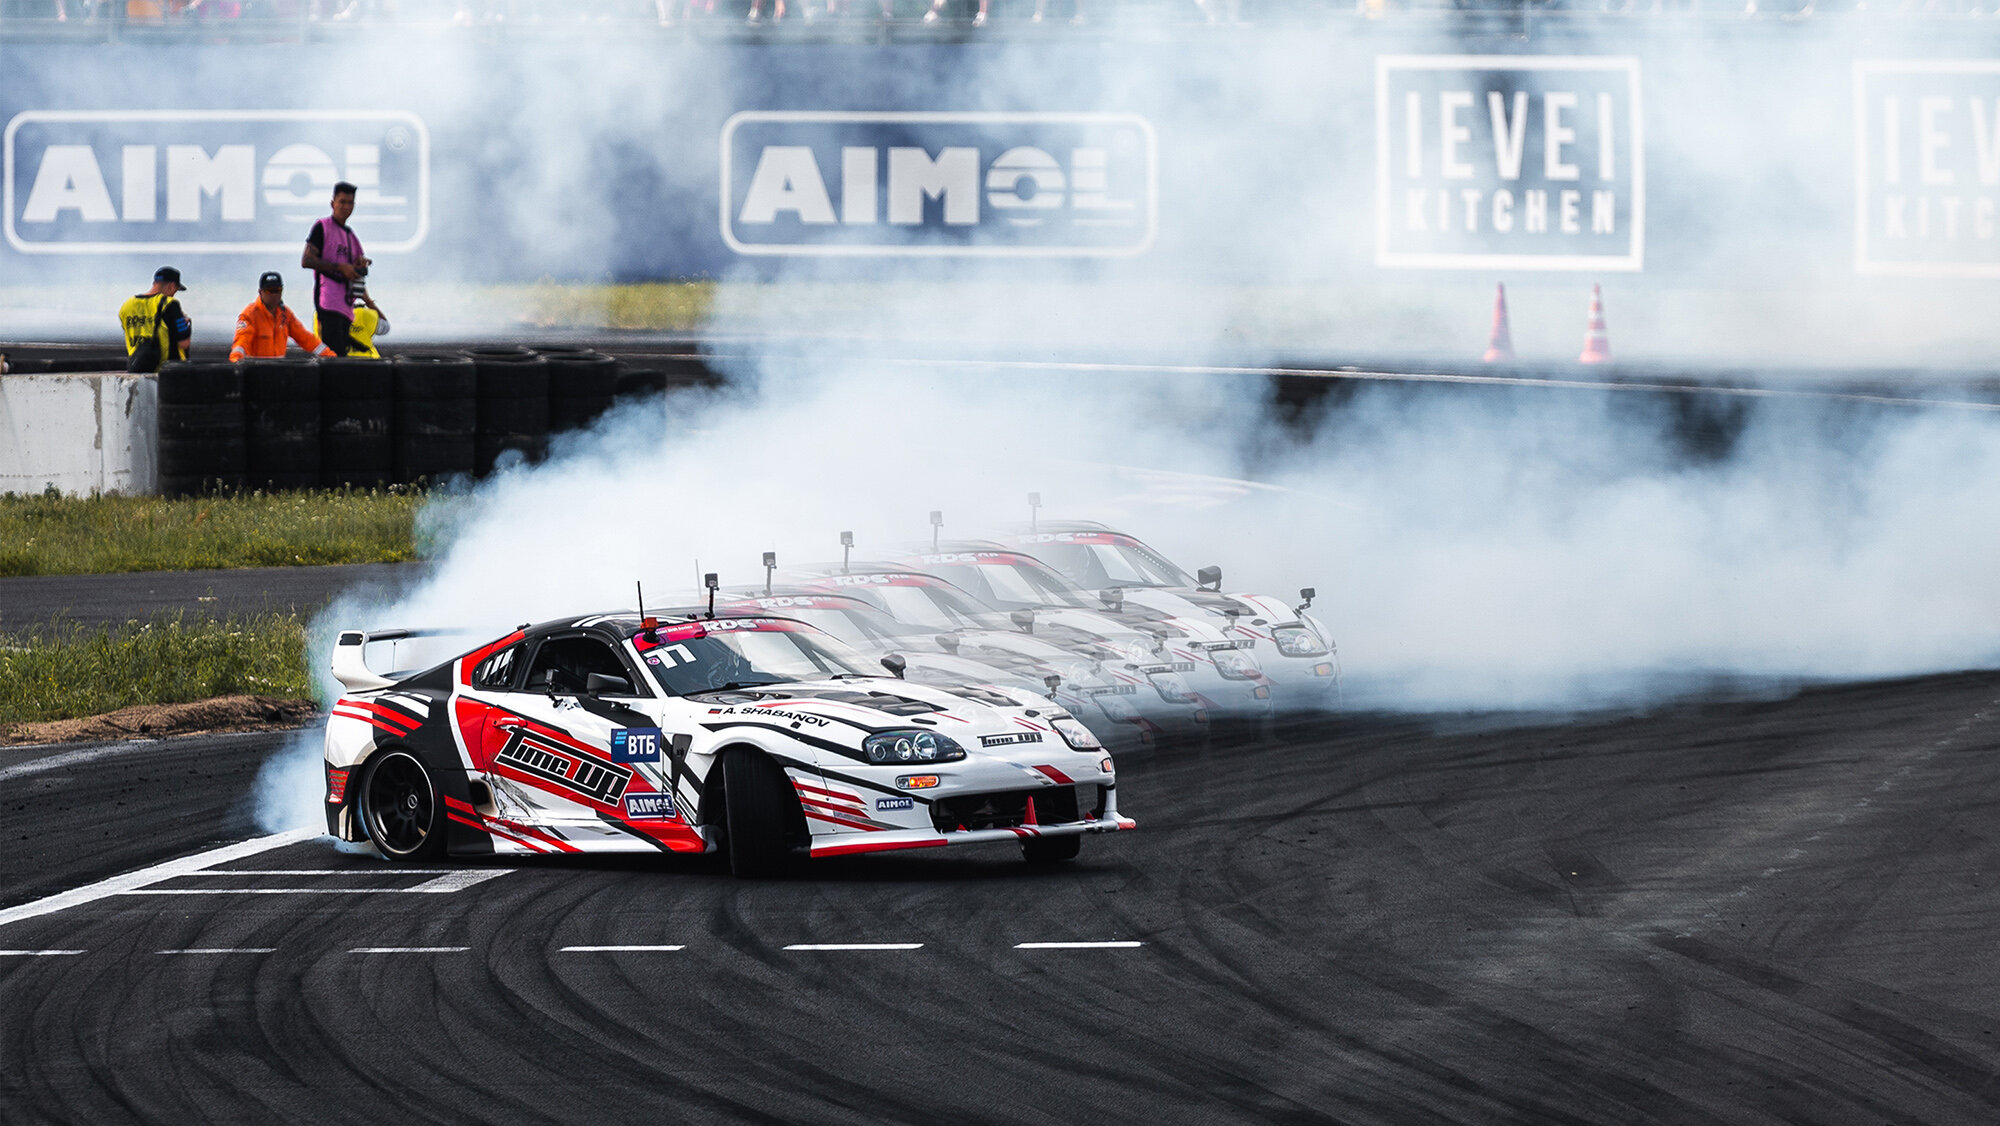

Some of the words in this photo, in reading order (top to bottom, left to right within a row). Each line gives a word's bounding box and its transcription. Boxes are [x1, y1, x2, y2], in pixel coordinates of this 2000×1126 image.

[21, 143, 408, 222] AIMOL
[738, 146, 1137, 226] AIMOL
[1405, 187, 1616, 234] KITCHEN
[700, 618, 759, 631] RDS
[643, 643, 697, 669] 77
[723, 707, 736, 715] A.
[740, 707, 830, 728] SHABANOV
[494, 726, 573, 777] Time
[628, 734, 656, 755] ВТБ
[629, 797, 673, 814] AIMOL
[878, 800, 912, 810] AIMOL
